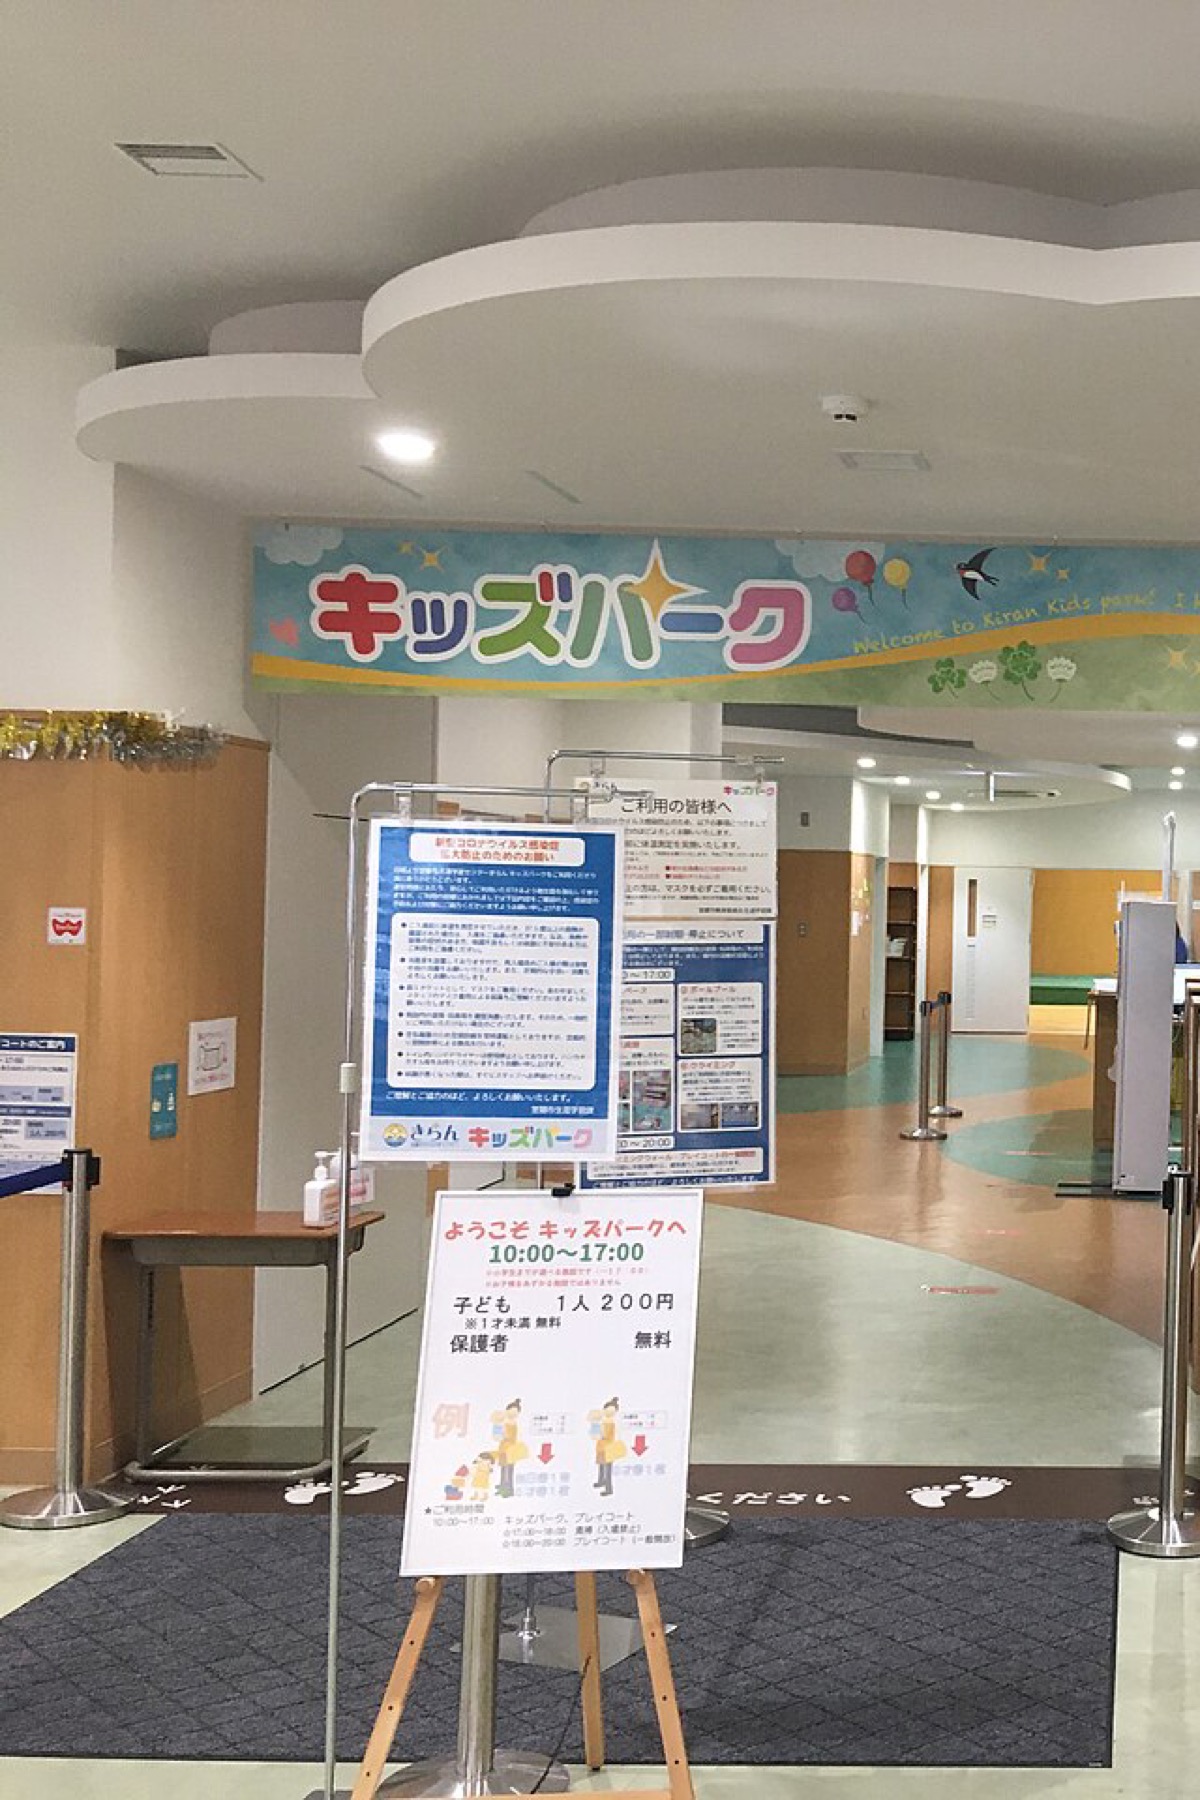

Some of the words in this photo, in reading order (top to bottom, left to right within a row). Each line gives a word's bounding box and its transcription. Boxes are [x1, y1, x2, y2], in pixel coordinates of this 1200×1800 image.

[313, 560, 812, 672] キッズパーク
[853, 626, 945, 654] Welcome
[952, 619, 975, 634] to
[1048, 593, 1090, 615] Kids
[620, 798, 733, 815] ご利用の皆様へ
[410, 1124, 460, 1142] きらん
[468, 1125, 594, 1148] キッズパーク
[444, 1219, 530, 1240] ようこそ
[539, 1218, 687, 1238] キッズパークへ
[488, 1242, 644, 1263] 10:00～17:00
[453, 1296, 511, 1313] 子ども
[601, 1293, 674, 1311] 200円
[535, 1317, 562, 1329] 無料
[450, 1333, 509, 1354] 保護者
[634, 1330, 672, 1350] 無料
[432, 1402, 470, 1439] 例
[686, 1491, 853, 1506] ください
[575, 1512, 634, 1522] プレイコート
